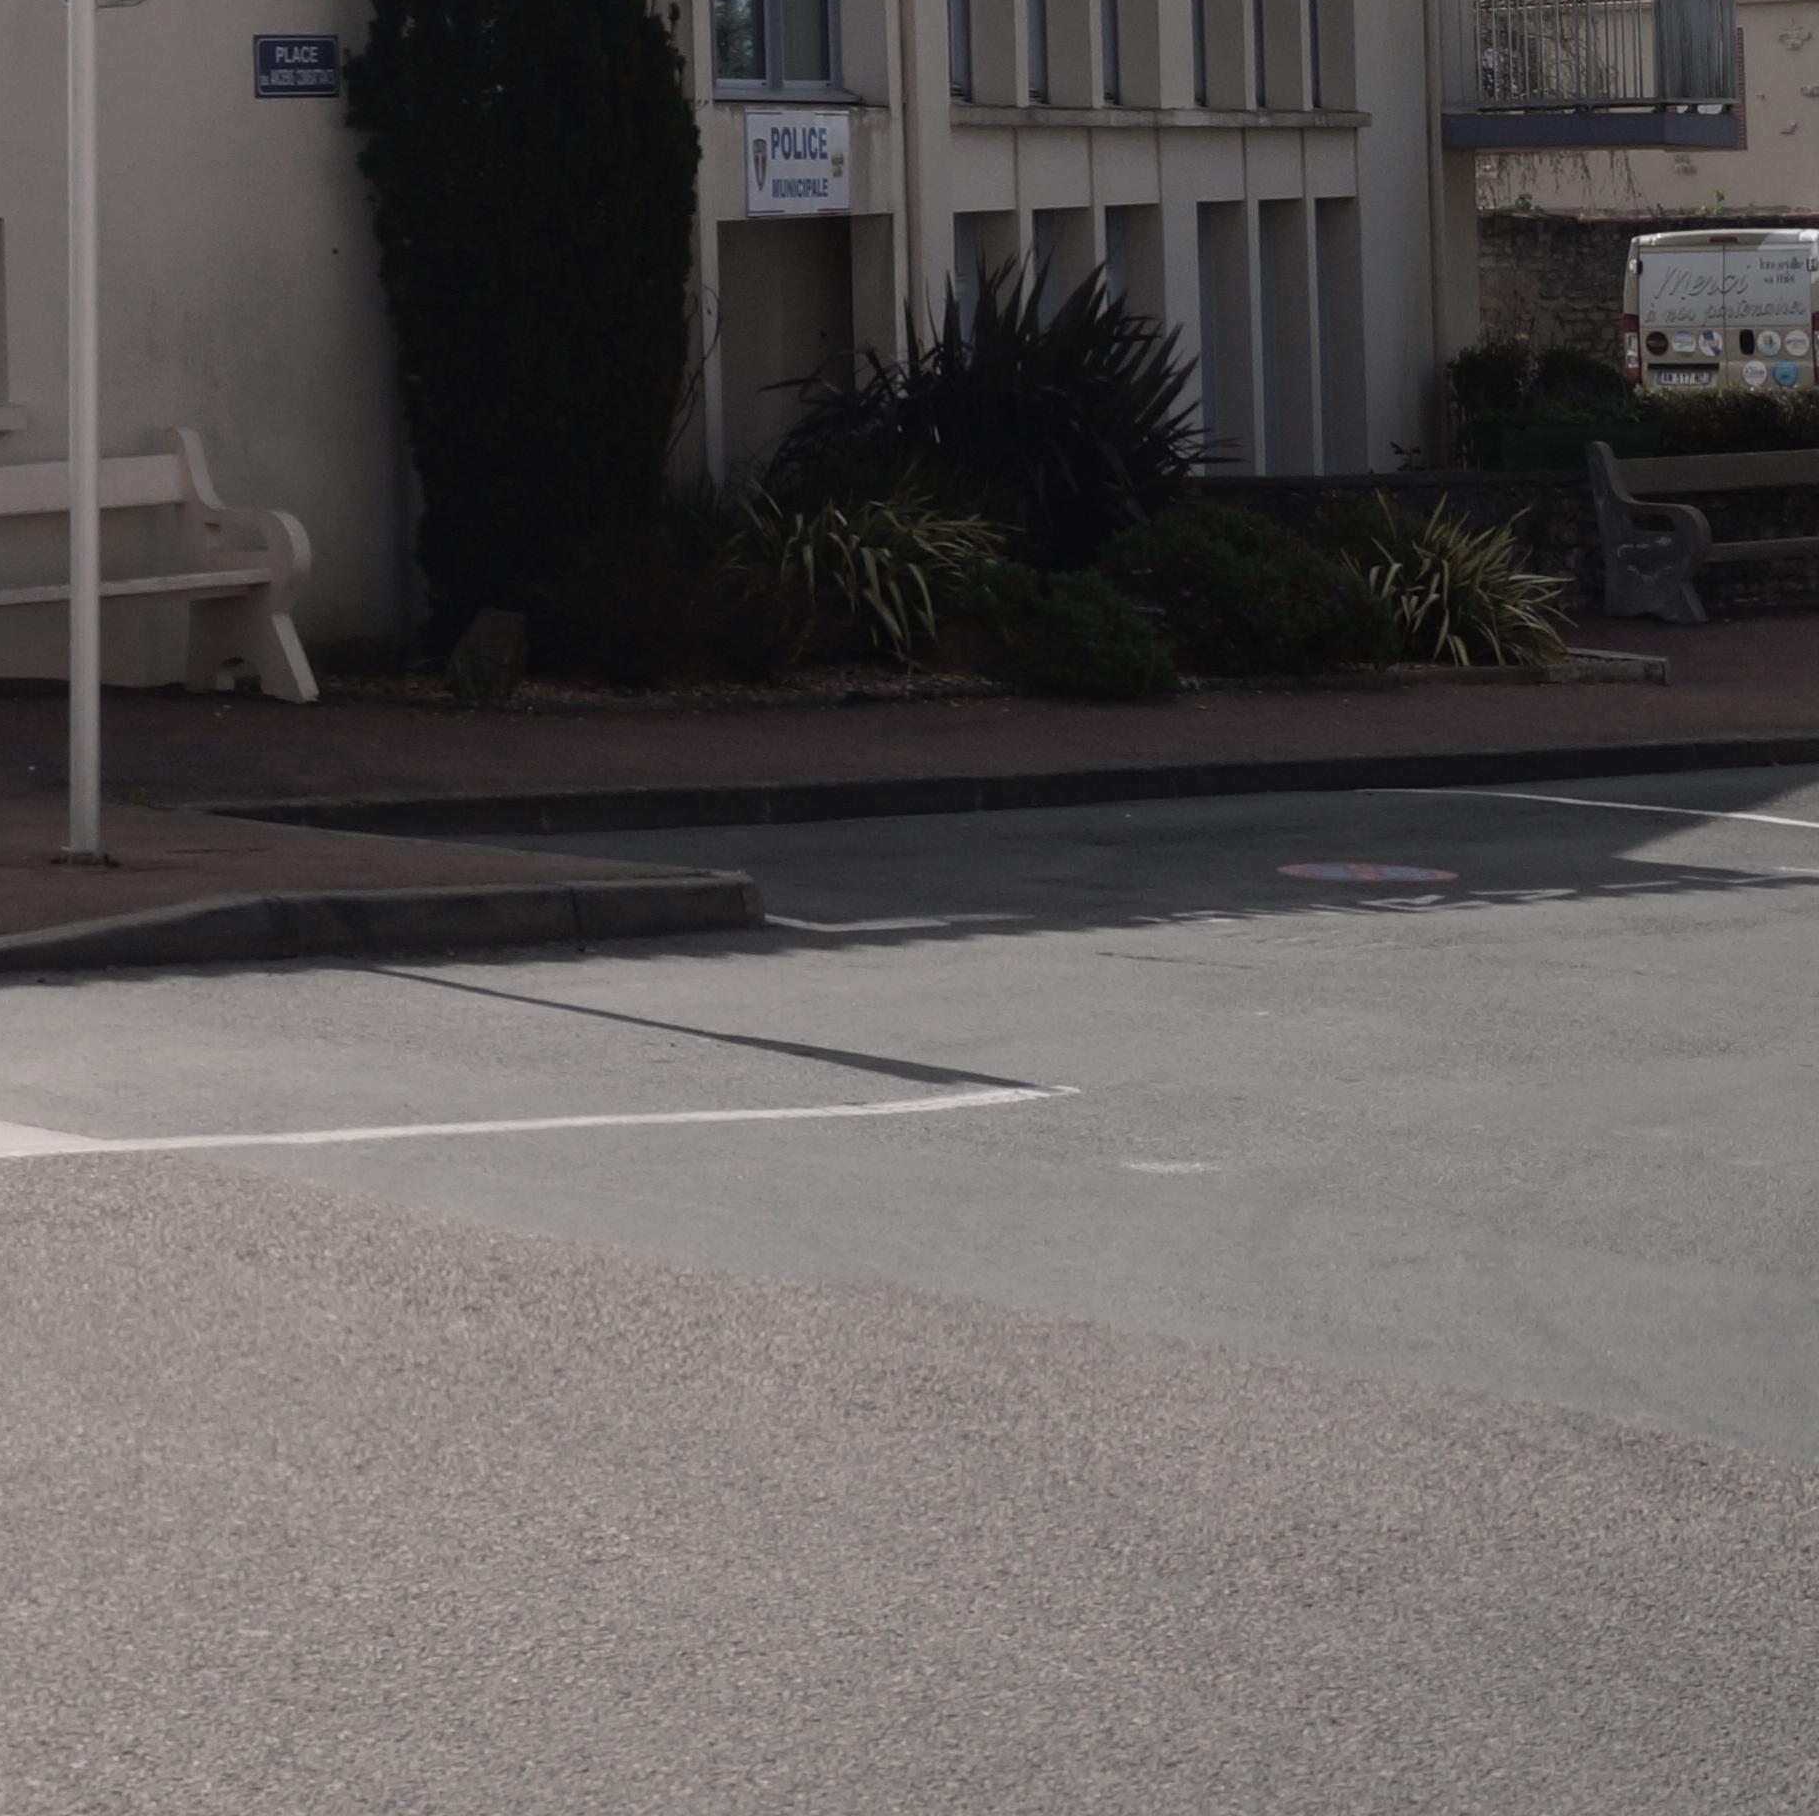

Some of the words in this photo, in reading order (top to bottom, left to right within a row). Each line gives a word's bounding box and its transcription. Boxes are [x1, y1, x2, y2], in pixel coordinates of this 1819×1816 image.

[275, 46, 319, 63] PLACE
[770, 126, 829, 160] POLICE
[771, 177, 830, 198] MUNICIPALE
[1653, 265, 1751, 300] Merci
